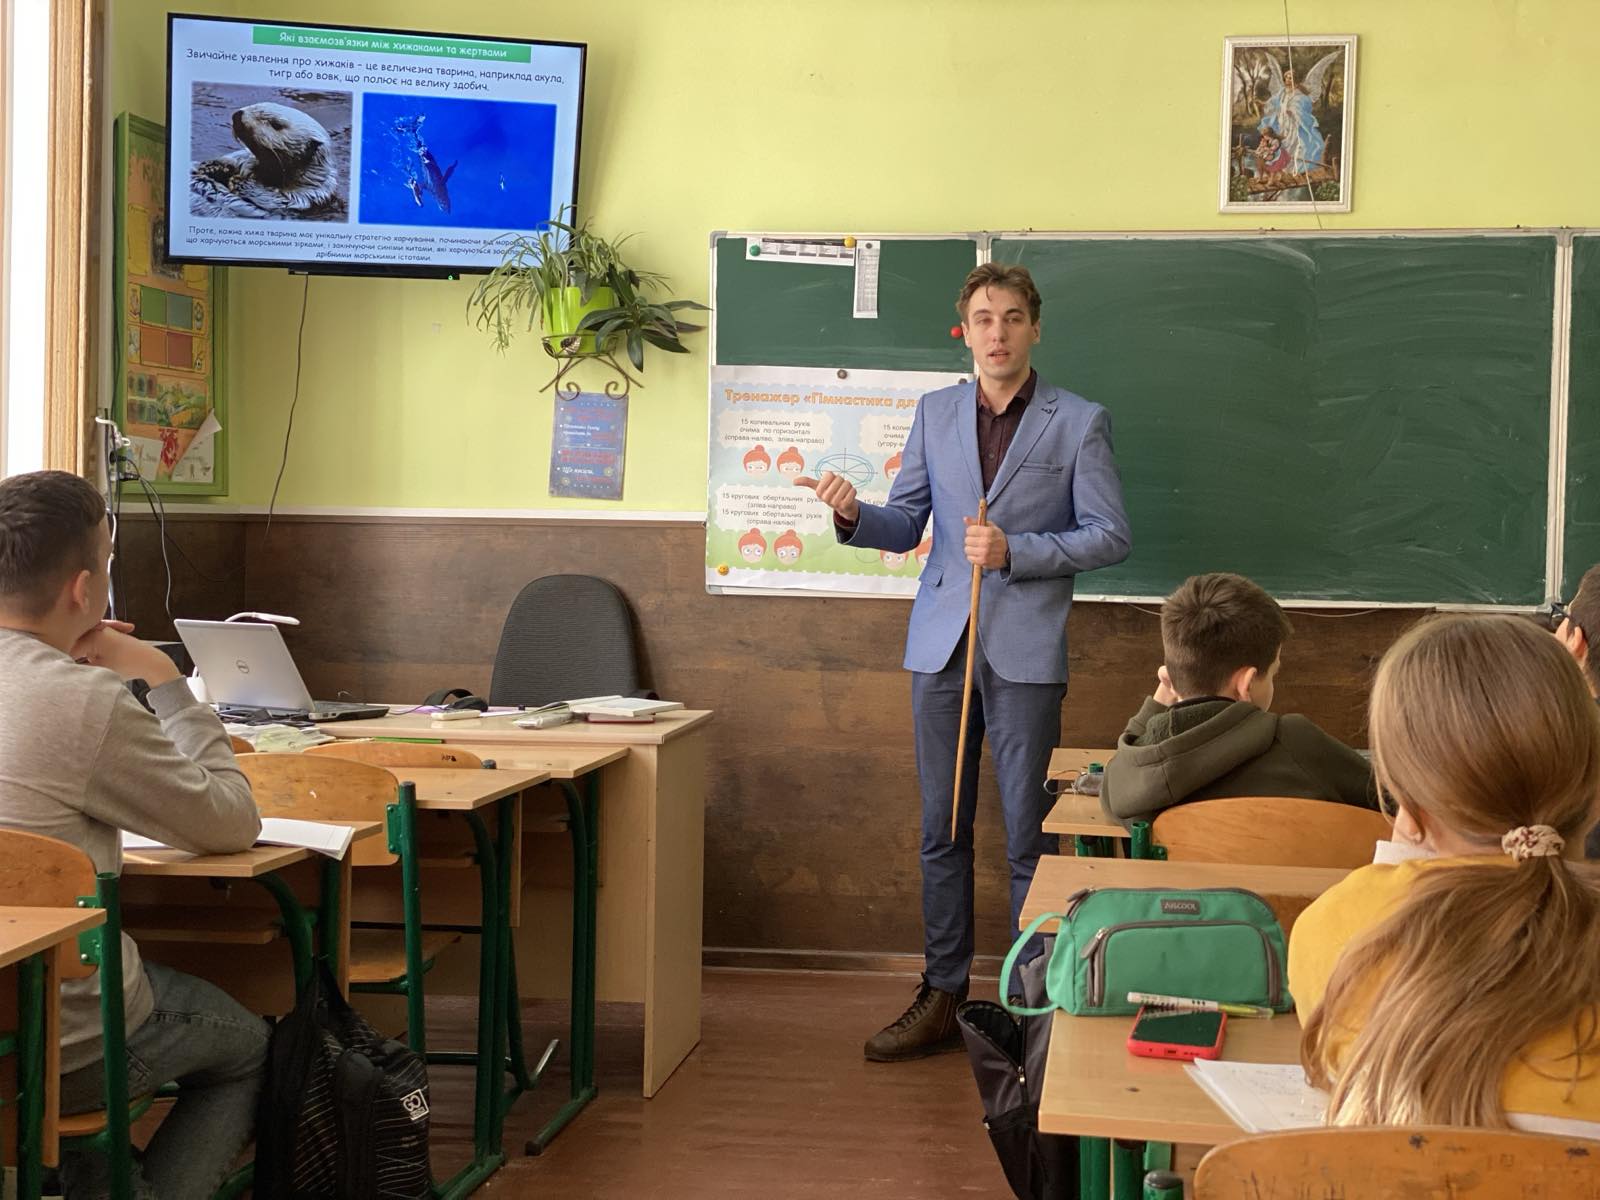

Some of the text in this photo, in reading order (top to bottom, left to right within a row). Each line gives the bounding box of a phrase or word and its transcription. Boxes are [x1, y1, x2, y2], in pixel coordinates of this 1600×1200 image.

[280, 32, 295, 42] Які
[371, 40, 390, 49] між
[393, 42, 443, 52] хижаками
[460, 48, 507, 57] жертвами
[187, 48, 238, 61] Звичайне
[240, 54, 288, 66] уявлення
[293, 58, 311, 68] про
[315, 58, 354, 69] хижаків
[366, 63, 378, 72] це
[382, 64, 433, 75] величезна
[436, 68, 477, 79] тварина,
[480, 71, 532, 82] наприклад
[534, 75, 564, 86] акула,
[270, 70, 490, 92] тигр або вовк, що полює на велику здобич.
[188, 226, 216, 234] Проте,
[294, 241, 326, 249] зірками,
[724, 388, 800, 406] Тренажер
